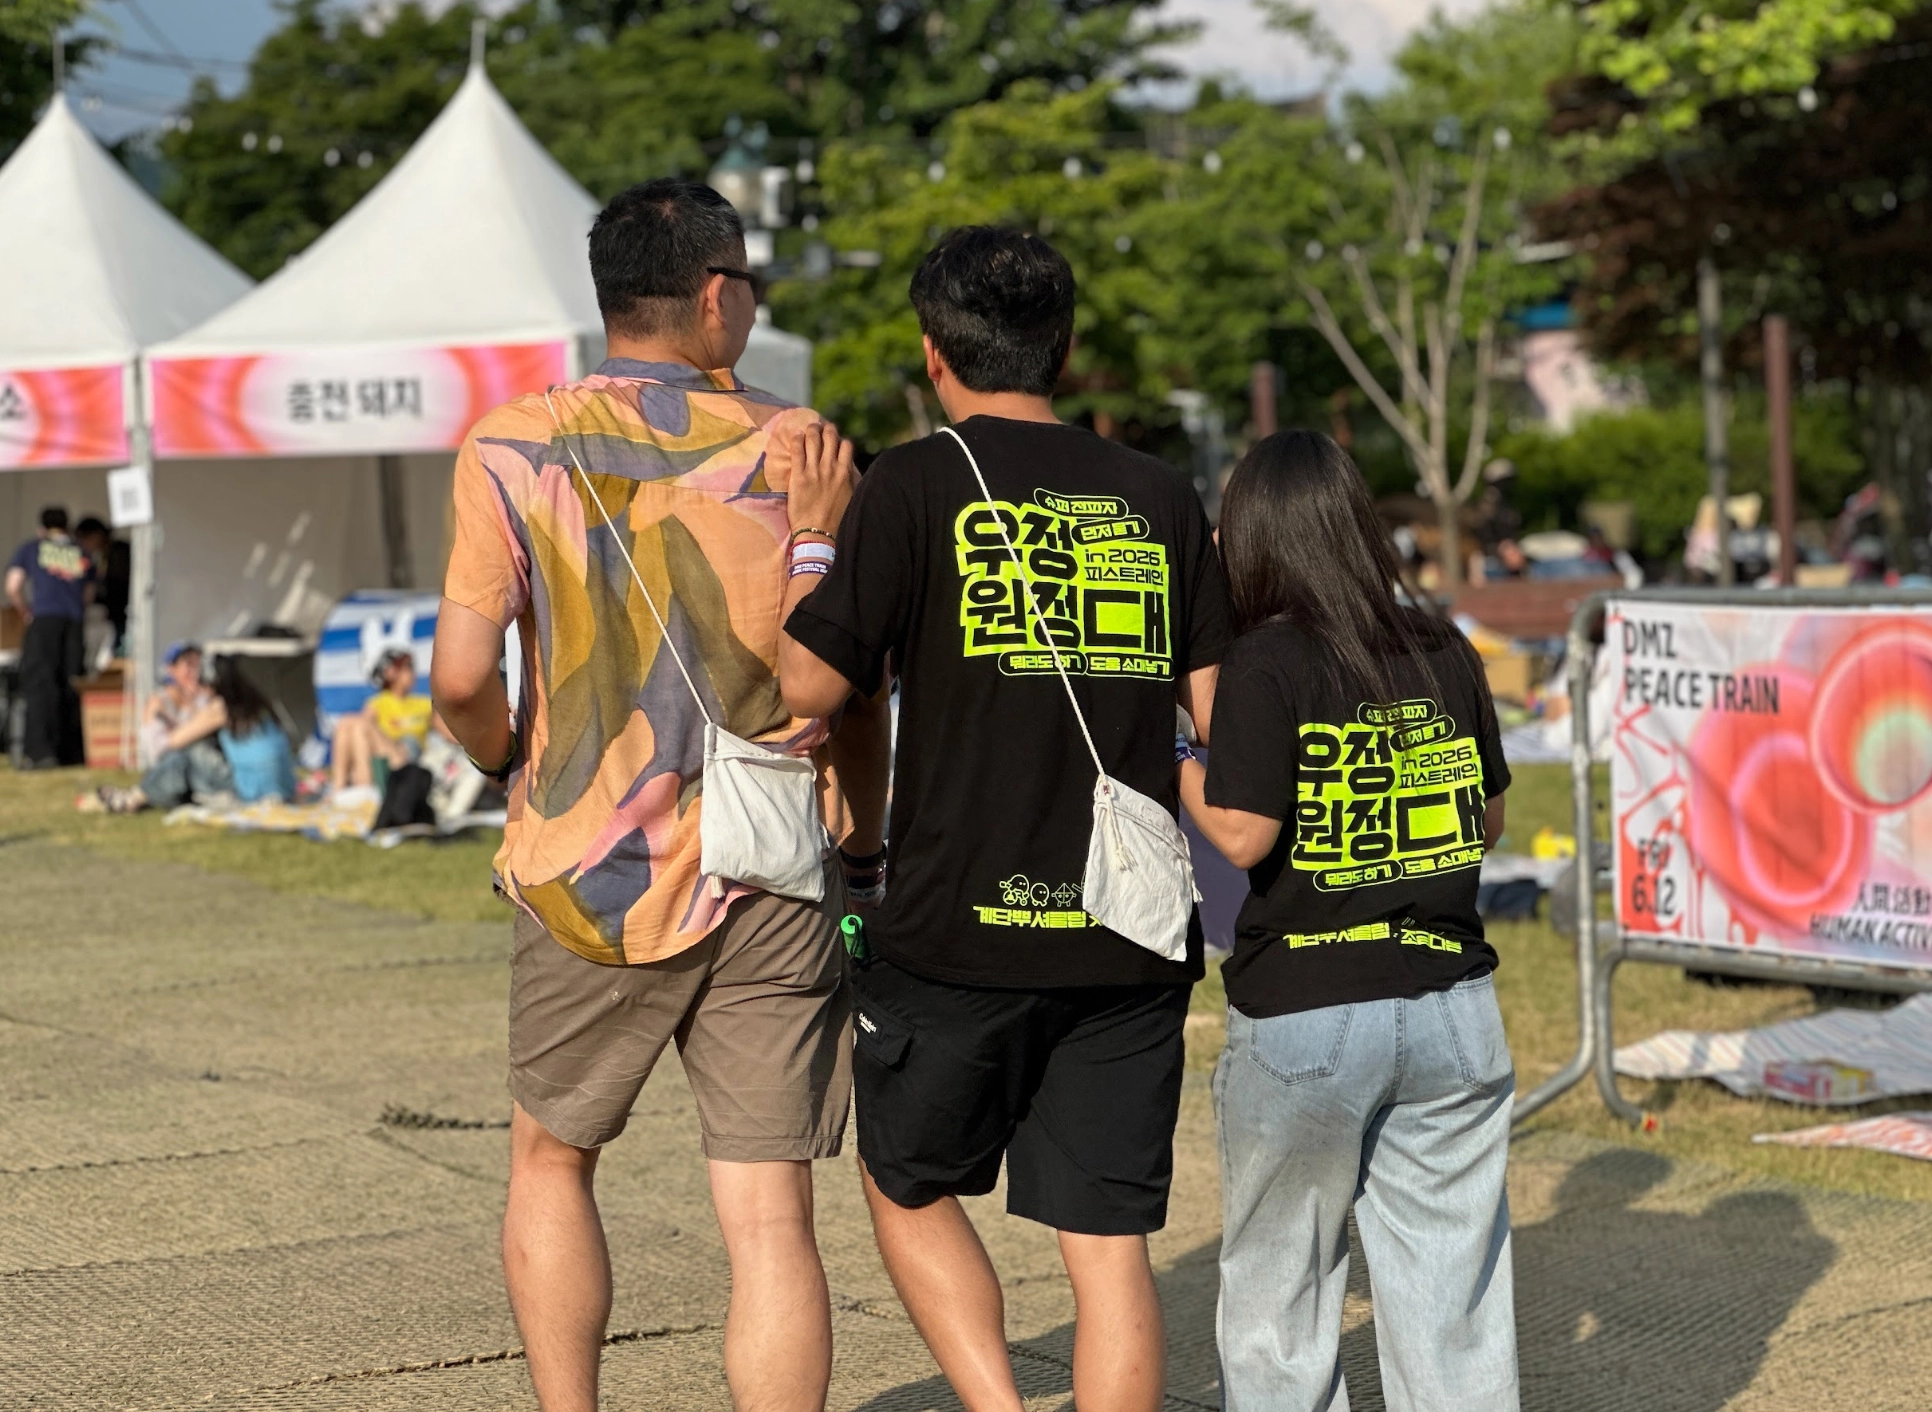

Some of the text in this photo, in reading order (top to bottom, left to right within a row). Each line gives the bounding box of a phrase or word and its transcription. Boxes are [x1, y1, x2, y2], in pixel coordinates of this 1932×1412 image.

[1044, 496, 1118, 515] 슈퍼 전파자
[1080, 523, 1112, 541] 먼저
[963, 509, 1079, 581] 우정
[1085, 549, 1161, 567] in 2026
[1084, 566, 1164, 587] 피스트레인
[1623, 619, 1677, 658] DMZ
[1009, 654, 1053, 670] 뭐라도
[1090, 656, 1121, 671] 도움
[1625, 666, 1779, 714] PEACE TRAIN
[1299, 730, 1396, 797] 우정
[1401, 745, 1472, 770] in 2026
[1399, 763, 1479, 788] 피스트레인
[1631, 875, 1676, 916] 6.12
[973, 905, 1087, 929] 계단뿌셔클럽
[1810, 913, 1874, 943] HUMAN
